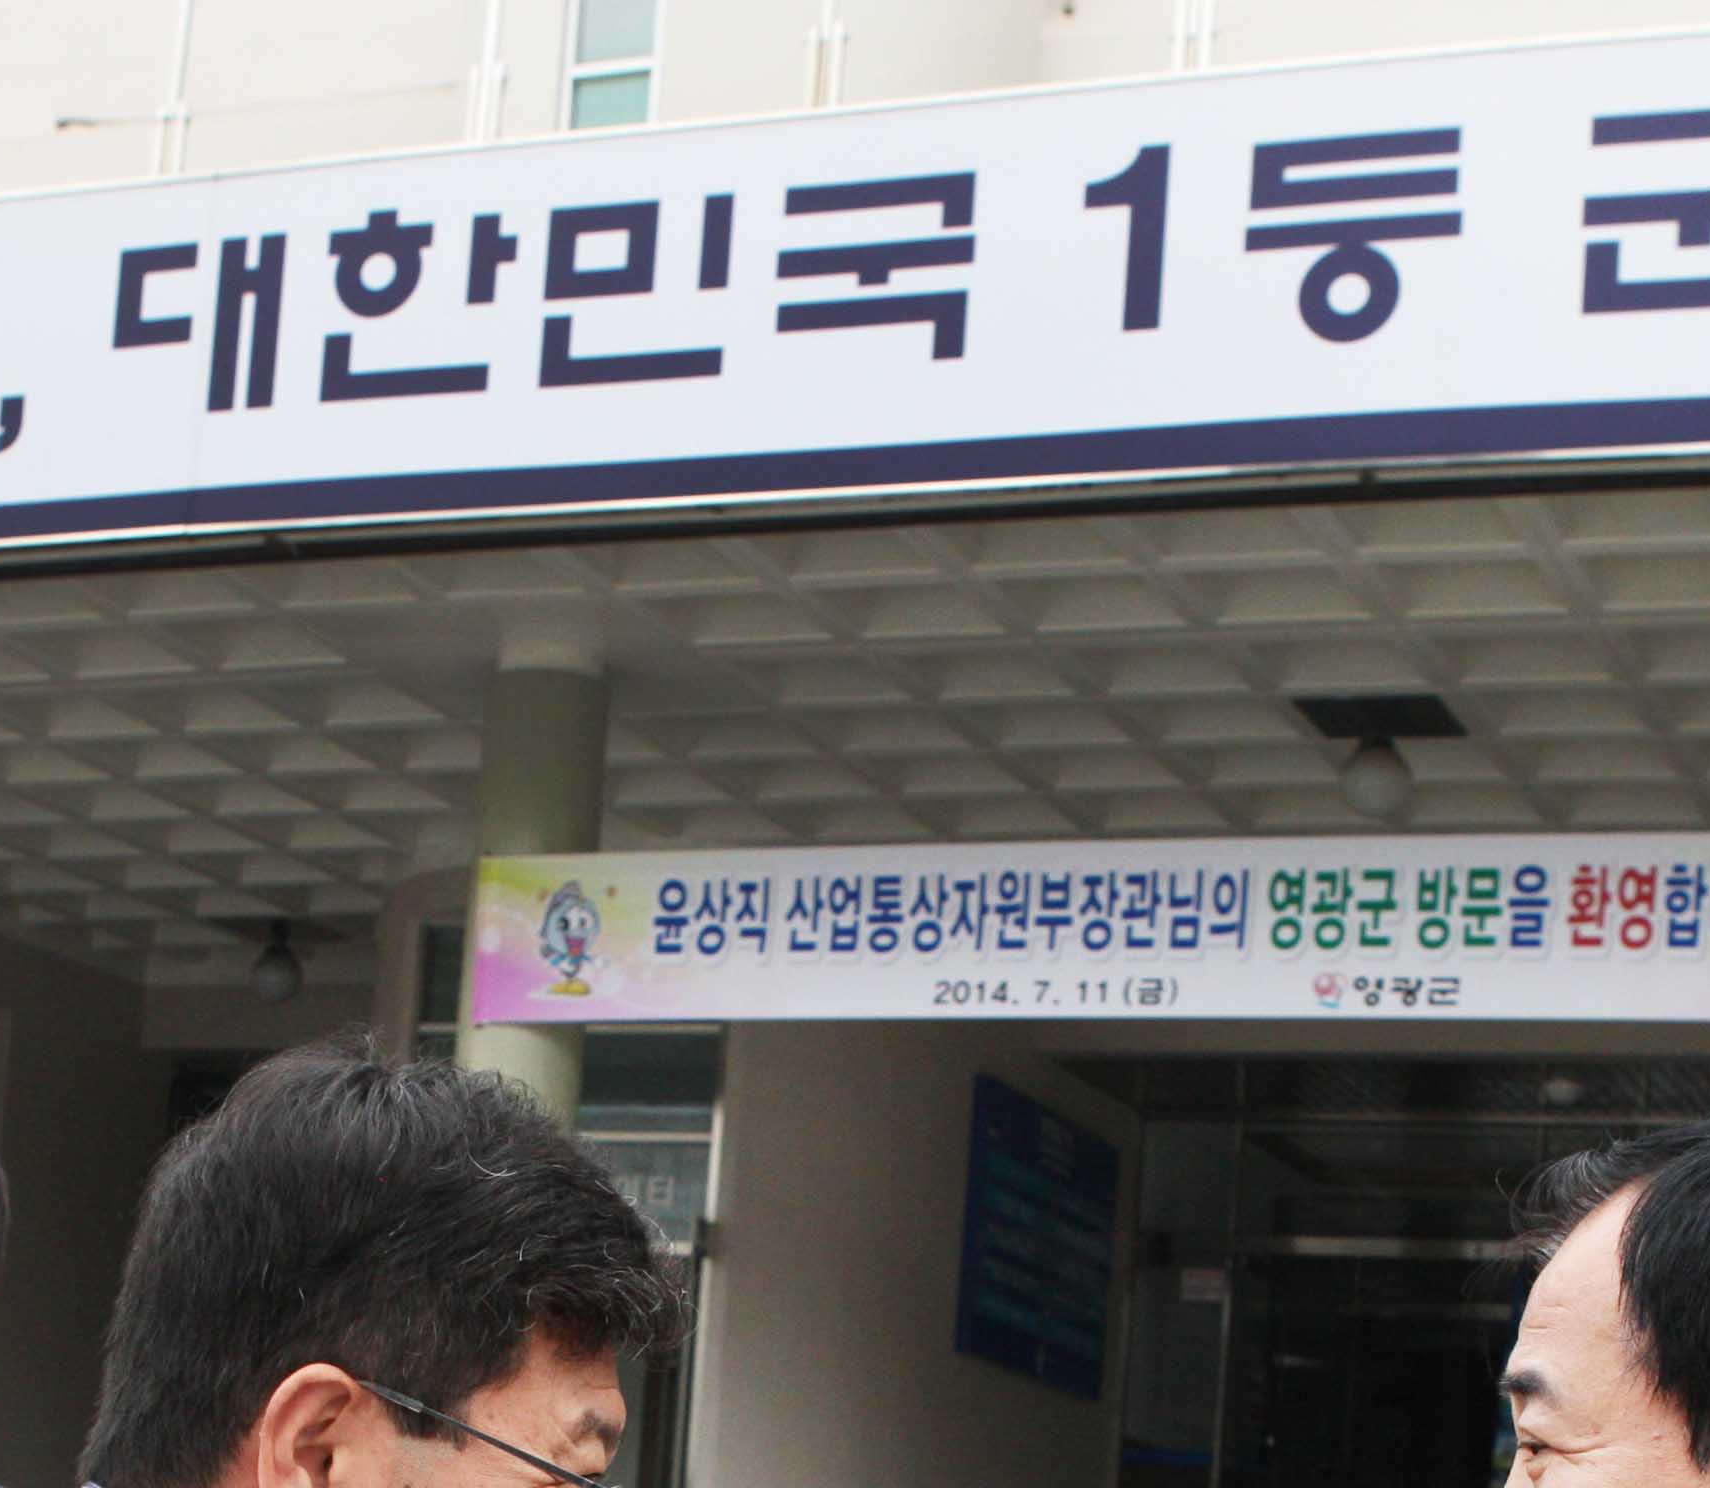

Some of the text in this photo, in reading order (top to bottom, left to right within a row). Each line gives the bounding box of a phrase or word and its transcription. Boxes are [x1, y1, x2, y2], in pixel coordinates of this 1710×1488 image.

[112, 170, 977, 413] 대한민국
[654, 879, 770, 955] 윤상직
[786, 869, 1249, 953] 산업통상자원부장관님의
[1269, 868, 1398, 950] 영광군
[1417, 864, 1550, 949] 방문을
[933, 980, 1019, 1005] 2014.
[1078, 980, 1108, 1003] 11
[1123, 977, 1178, 1006] (금)
[1353, 975, 1460, 1007] 영광군
